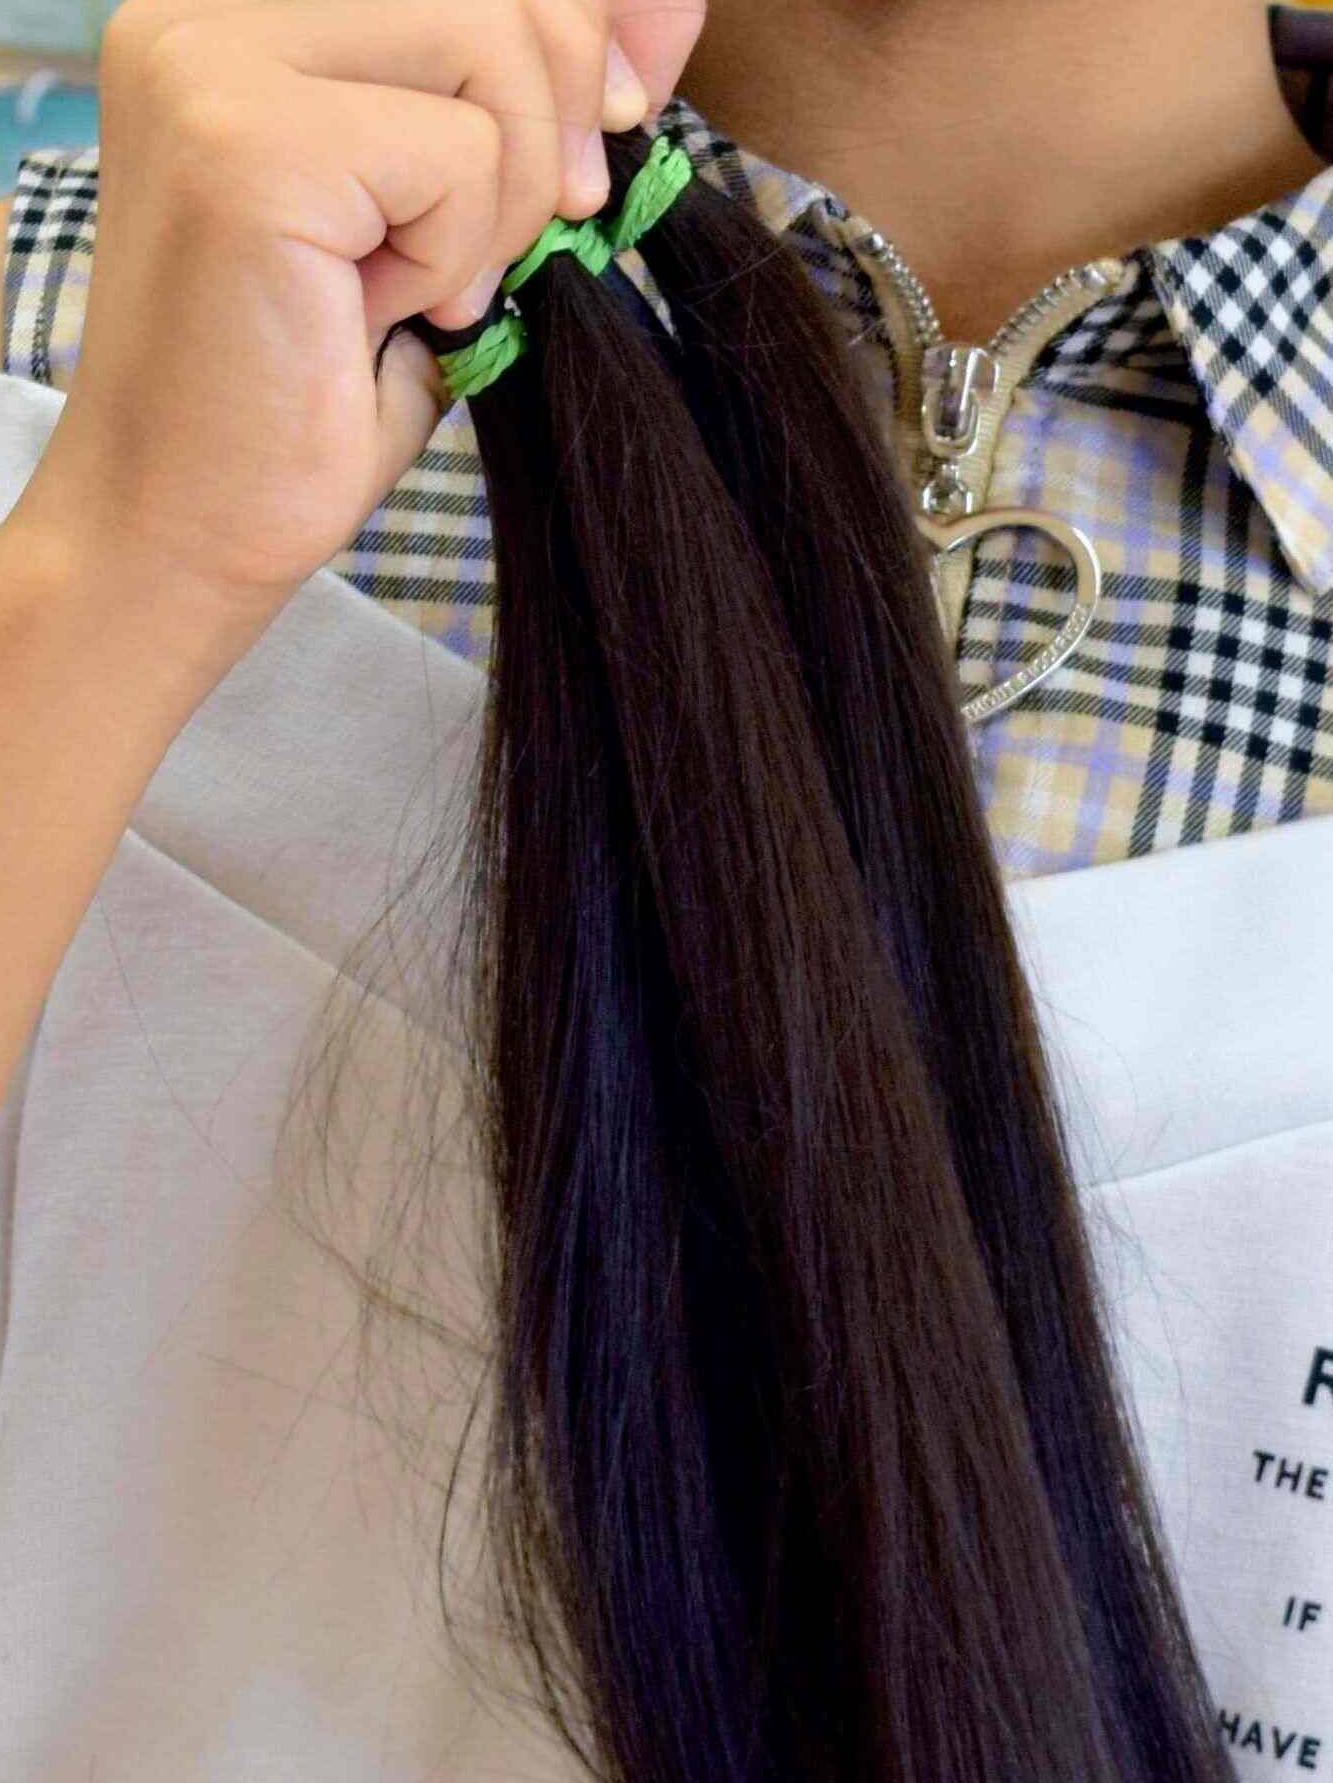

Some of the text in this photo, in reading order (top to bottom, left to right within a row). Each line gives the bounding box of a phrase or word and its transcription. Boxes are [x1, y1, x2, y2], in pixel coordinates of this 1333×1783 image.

[1252, 1449, 1330, 1501] THE
[1282, 1595, 1323, 1633] IF
[1217, 1709, 1322, 1771] HAVE
